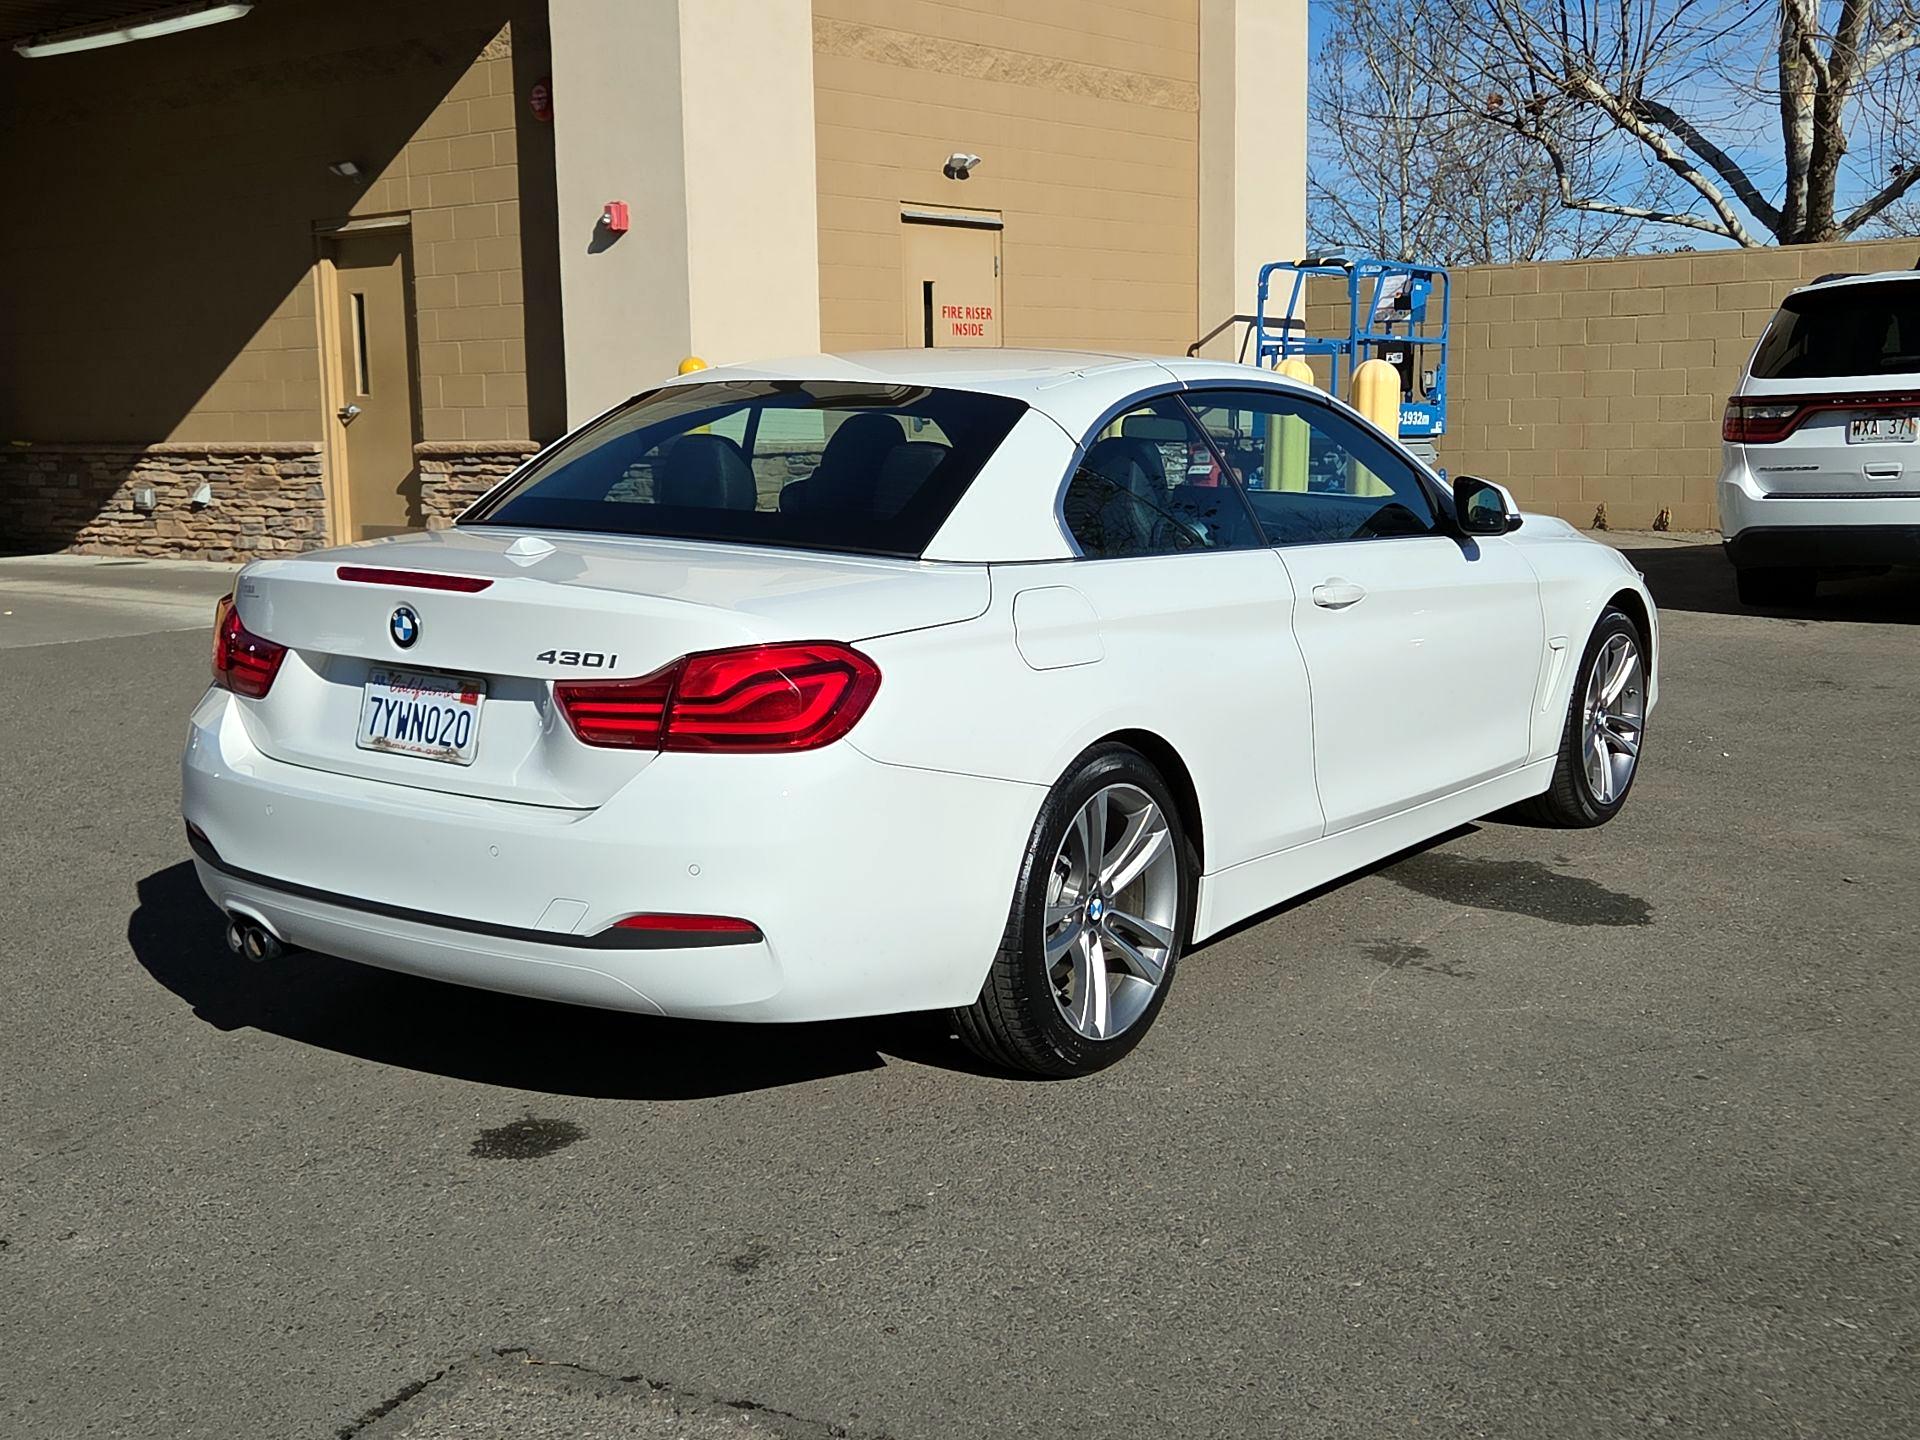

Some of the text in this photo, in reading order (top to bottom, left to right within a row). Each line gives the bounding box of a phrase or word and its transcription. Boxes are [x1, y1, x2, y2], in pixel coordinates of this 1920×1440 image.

[942, 305, 992, 320] FIRE RISER
[952, 323, 984, 336] INSIDE
[1399, 411, 1430, 426] -1932m
[369, 696, 471, 749] 7YWN020
